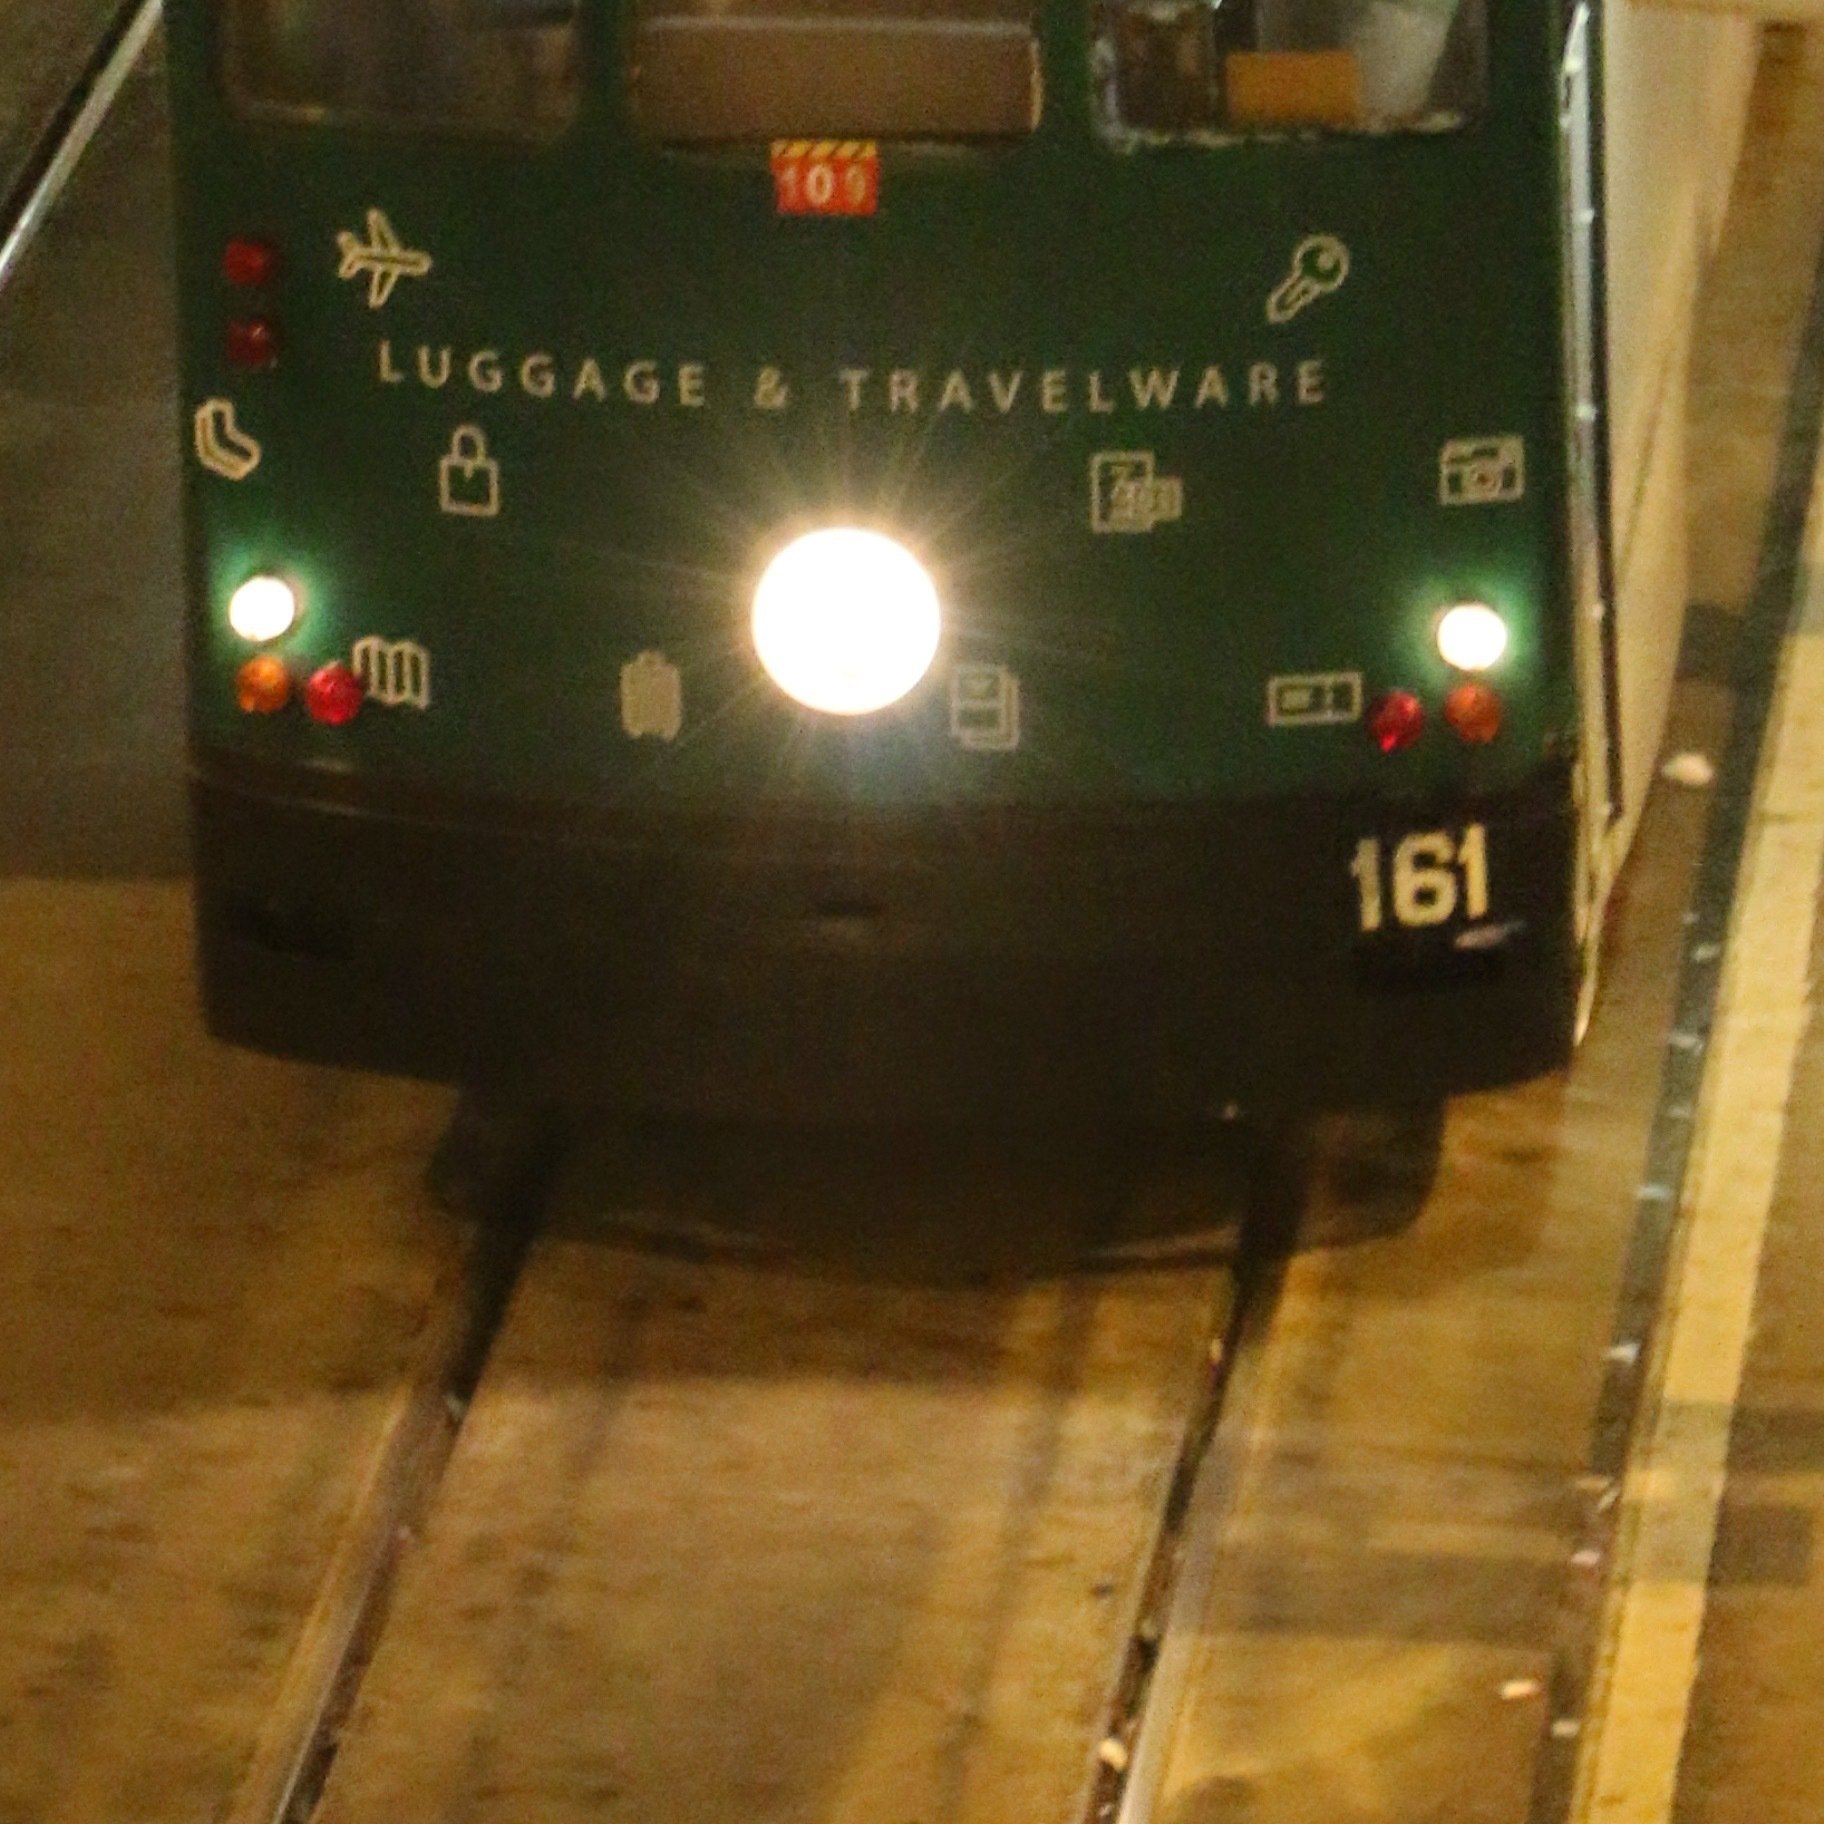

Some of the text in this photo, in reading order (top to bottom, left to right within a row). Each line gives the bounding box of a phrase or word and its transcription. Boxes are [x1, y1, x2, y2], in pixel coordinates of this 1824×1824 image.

[378, 339, 1326, 414] LUGGAGE & TRAVELWARE
[1351, 821, 1489, 932] 161
